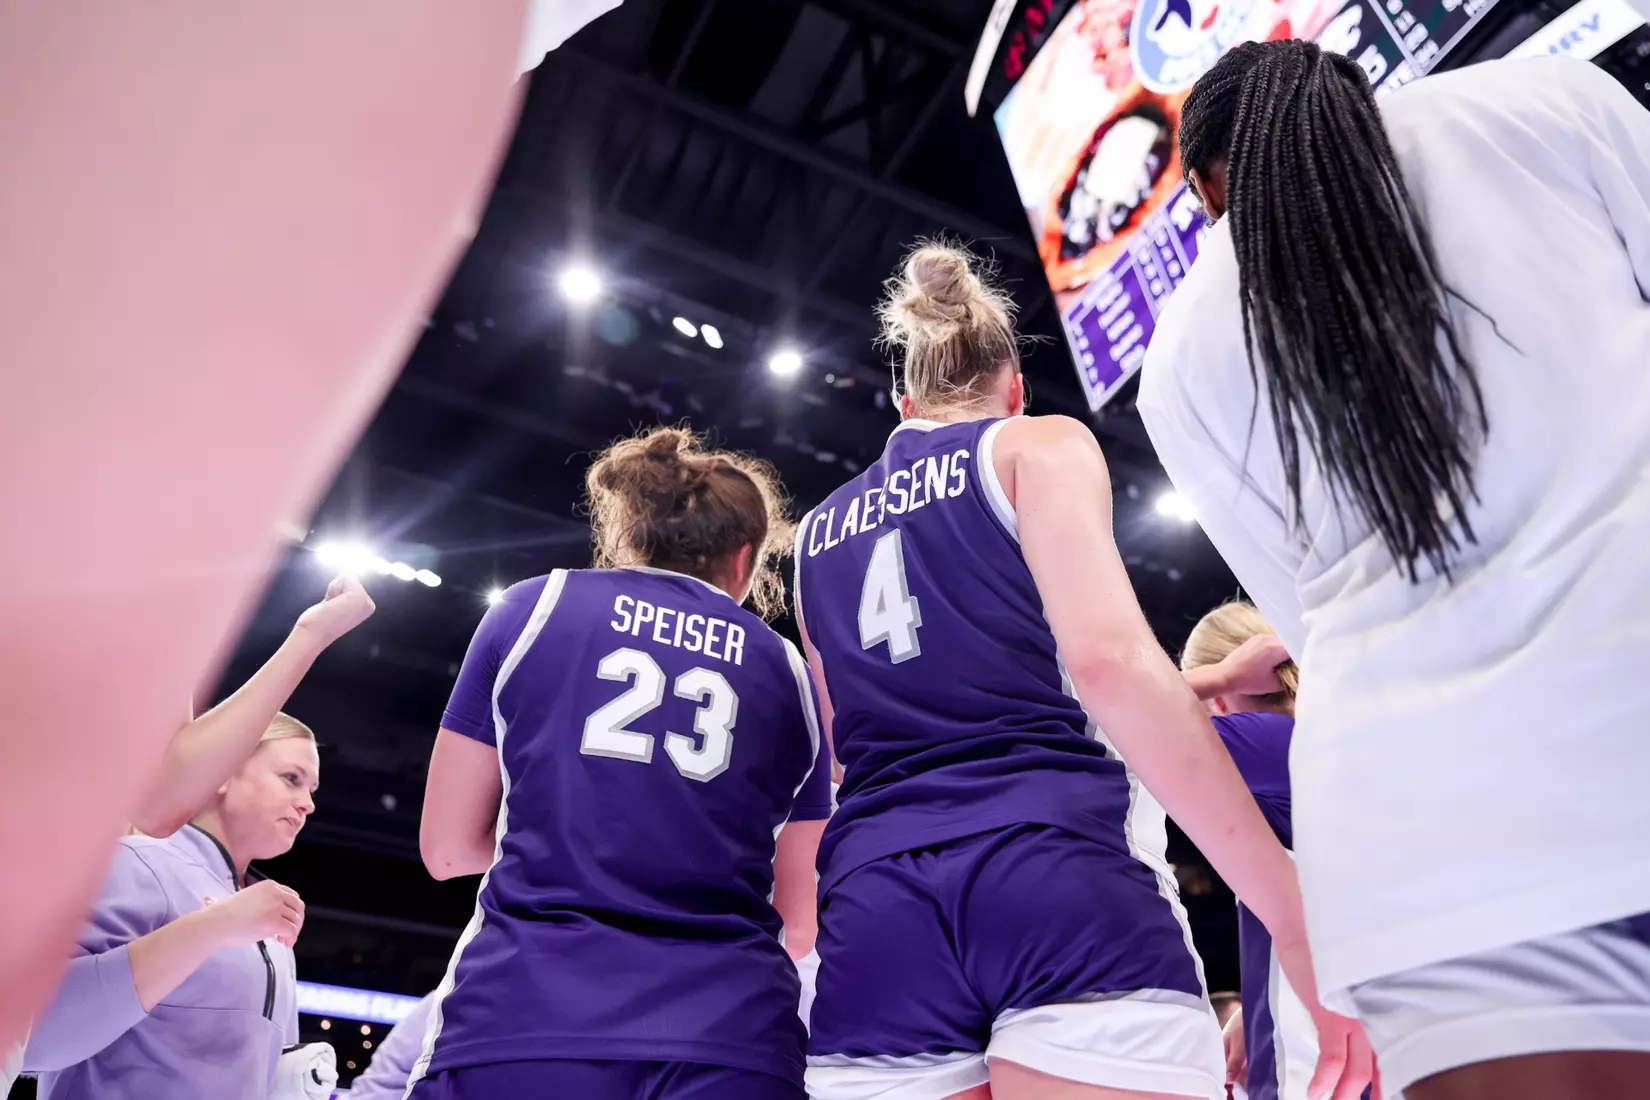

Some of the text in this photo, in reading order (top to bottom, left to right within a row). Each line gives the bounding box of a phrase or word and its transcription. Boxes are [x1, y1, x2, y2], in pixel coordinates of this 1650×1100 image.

[611, 595, 746, 666] SPEISER
[858, 528, 922, 665] 4
[580, 647, 740, 783] 23
